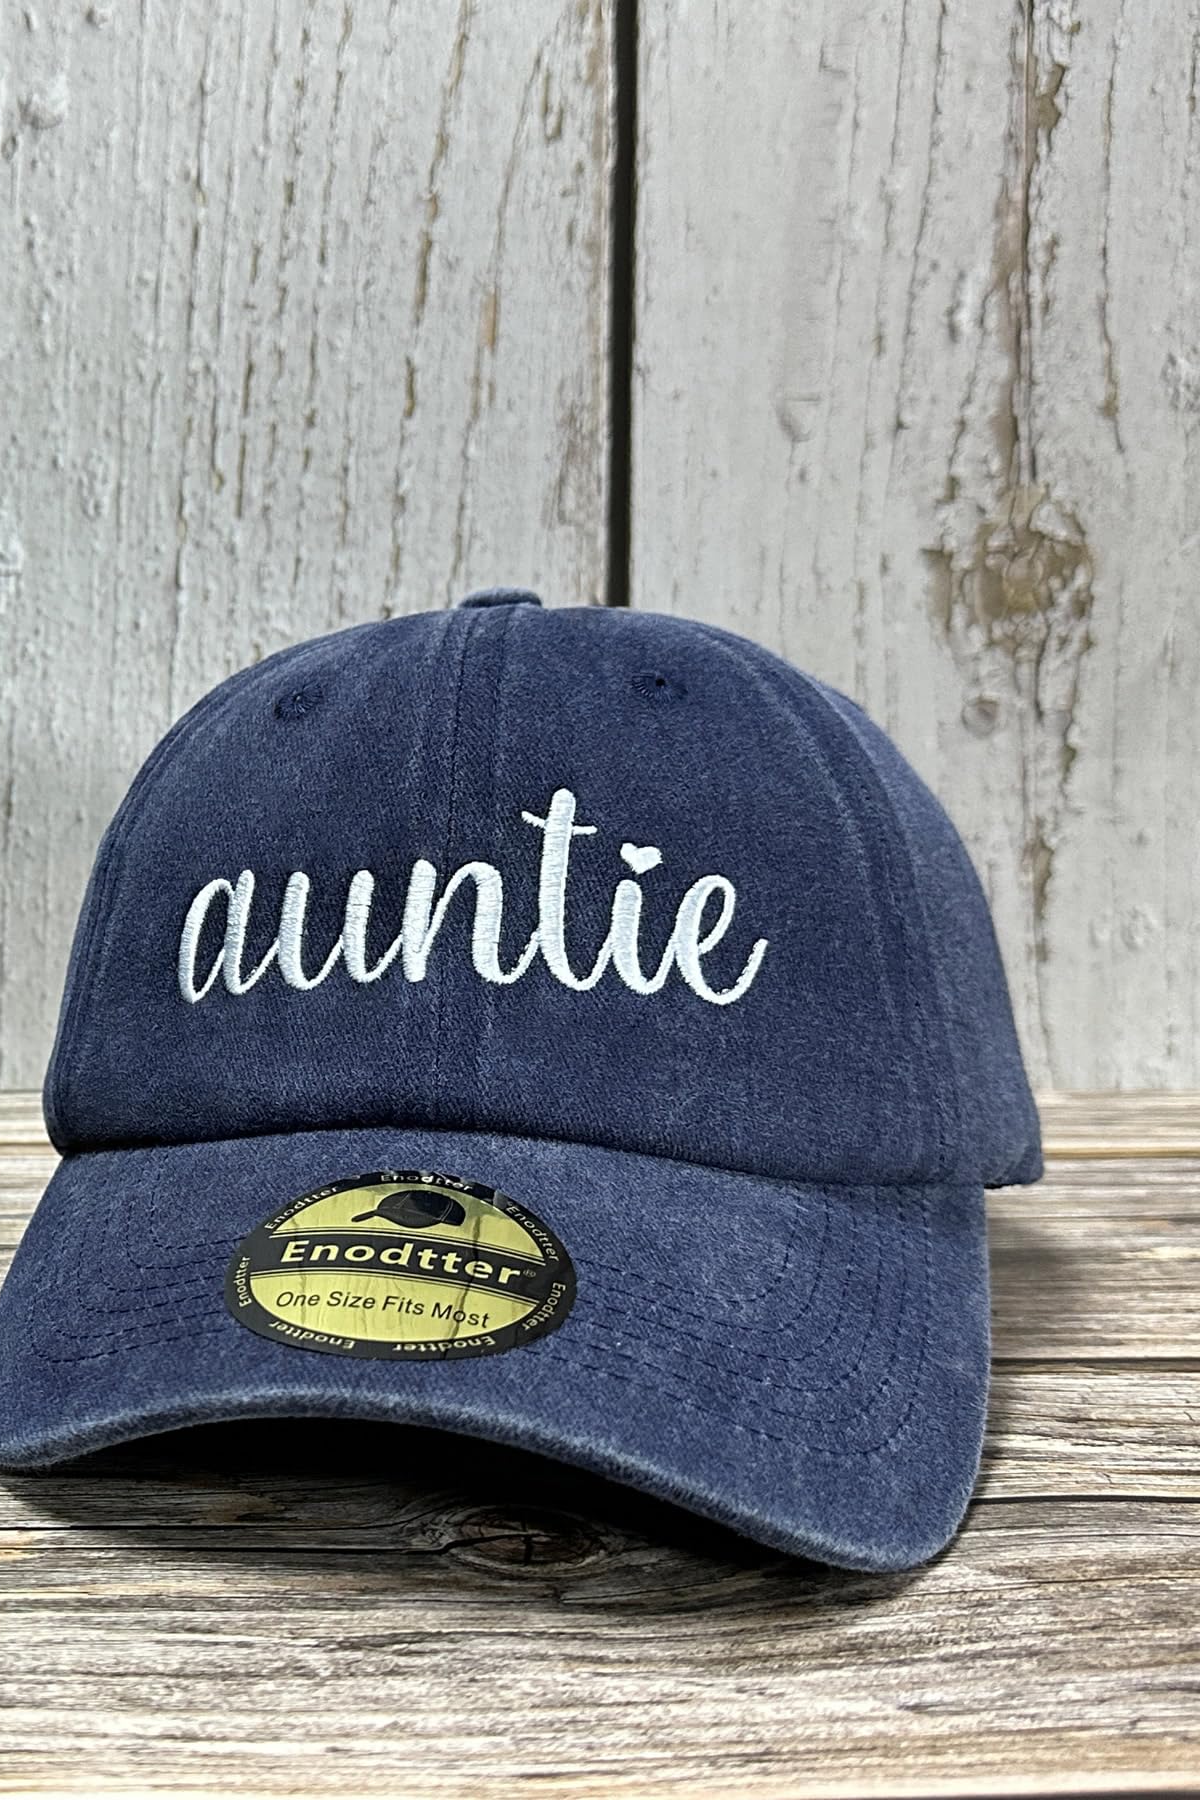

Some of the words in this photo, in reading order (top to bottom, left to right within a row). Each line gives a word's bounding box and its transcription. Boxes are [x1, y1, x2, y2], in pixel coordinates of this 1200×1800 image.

[179, 789, 768, 1005] auntie
[264, 1185, 339, 1231] Enodtter
[505, 1203, 561, 1262] Enodtter
[280, 1239, 521, 1285] Enodtter
[276, 1291, 321, 1308] One
[327, 1290, 376, 1310] Size
[382, 1295, 425, 1316] Fits
[431, 1302, 490, 1328] Most
